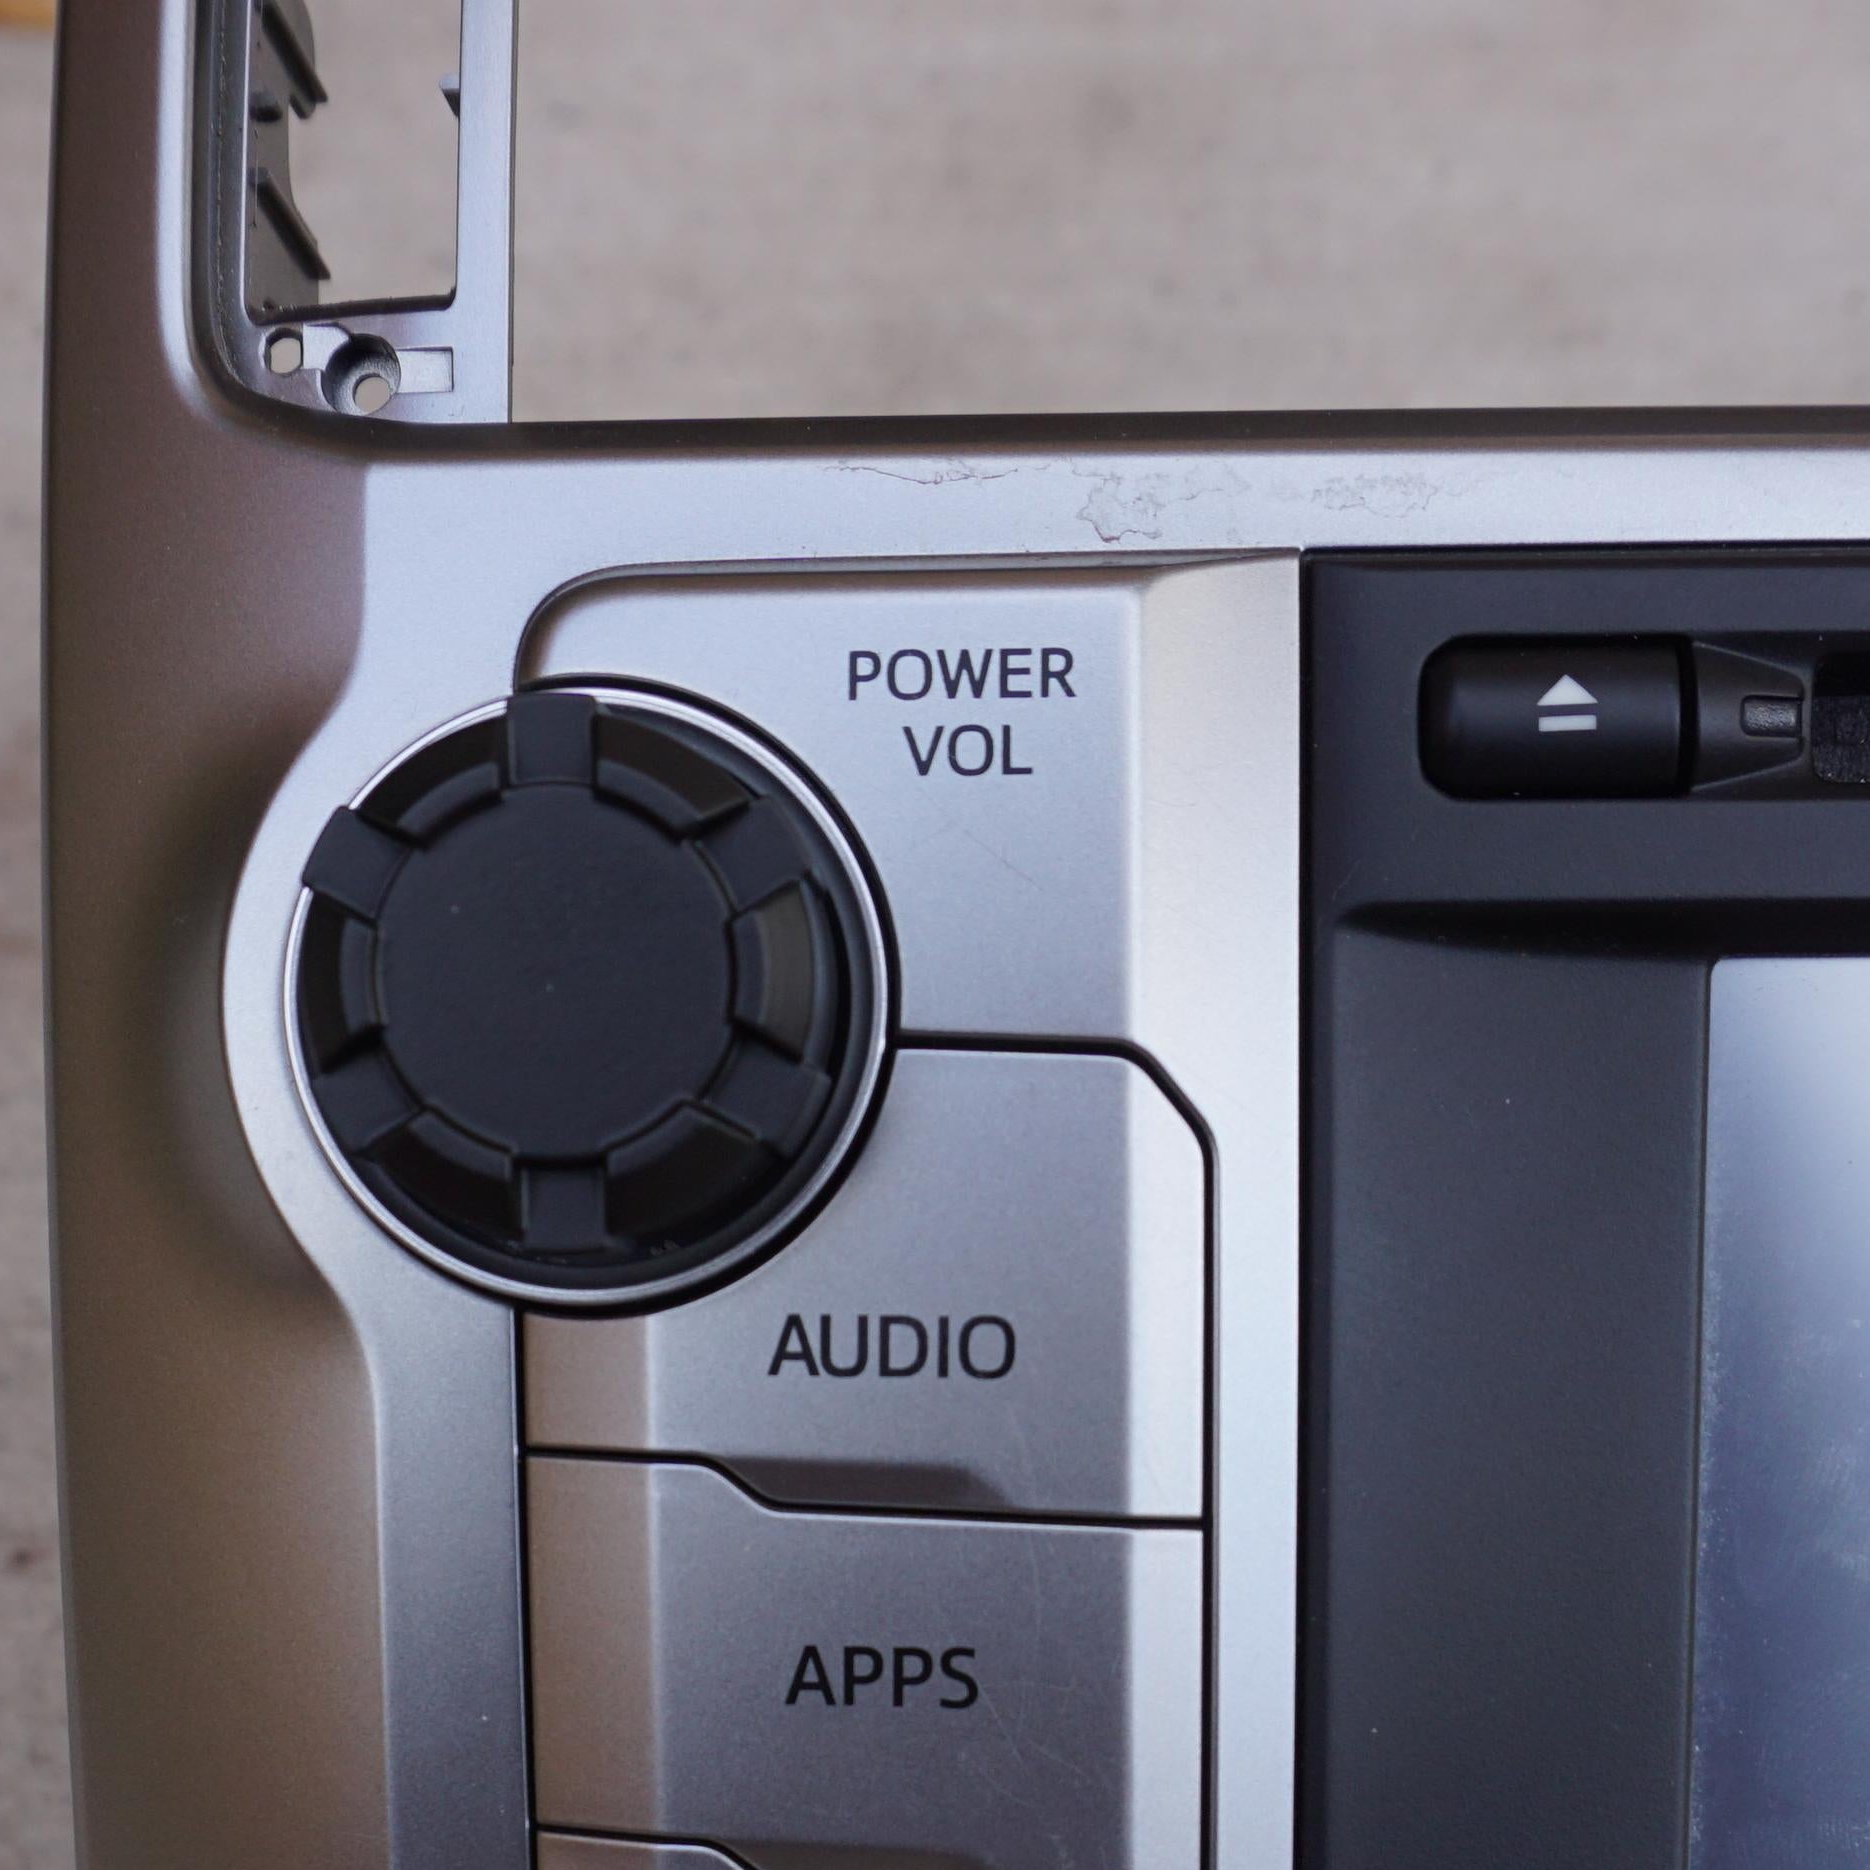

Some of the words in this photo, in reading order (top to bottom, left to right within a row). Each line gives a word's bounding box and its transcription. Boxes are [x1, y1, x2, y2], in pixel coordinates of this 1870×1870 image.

[847, 647, 1077, 701] POWER
[902, 724, 1034, 777] VOL
[767, 1313, 1017, 1379] AUDIO
[784, 1645, 979, 1709] APPS
